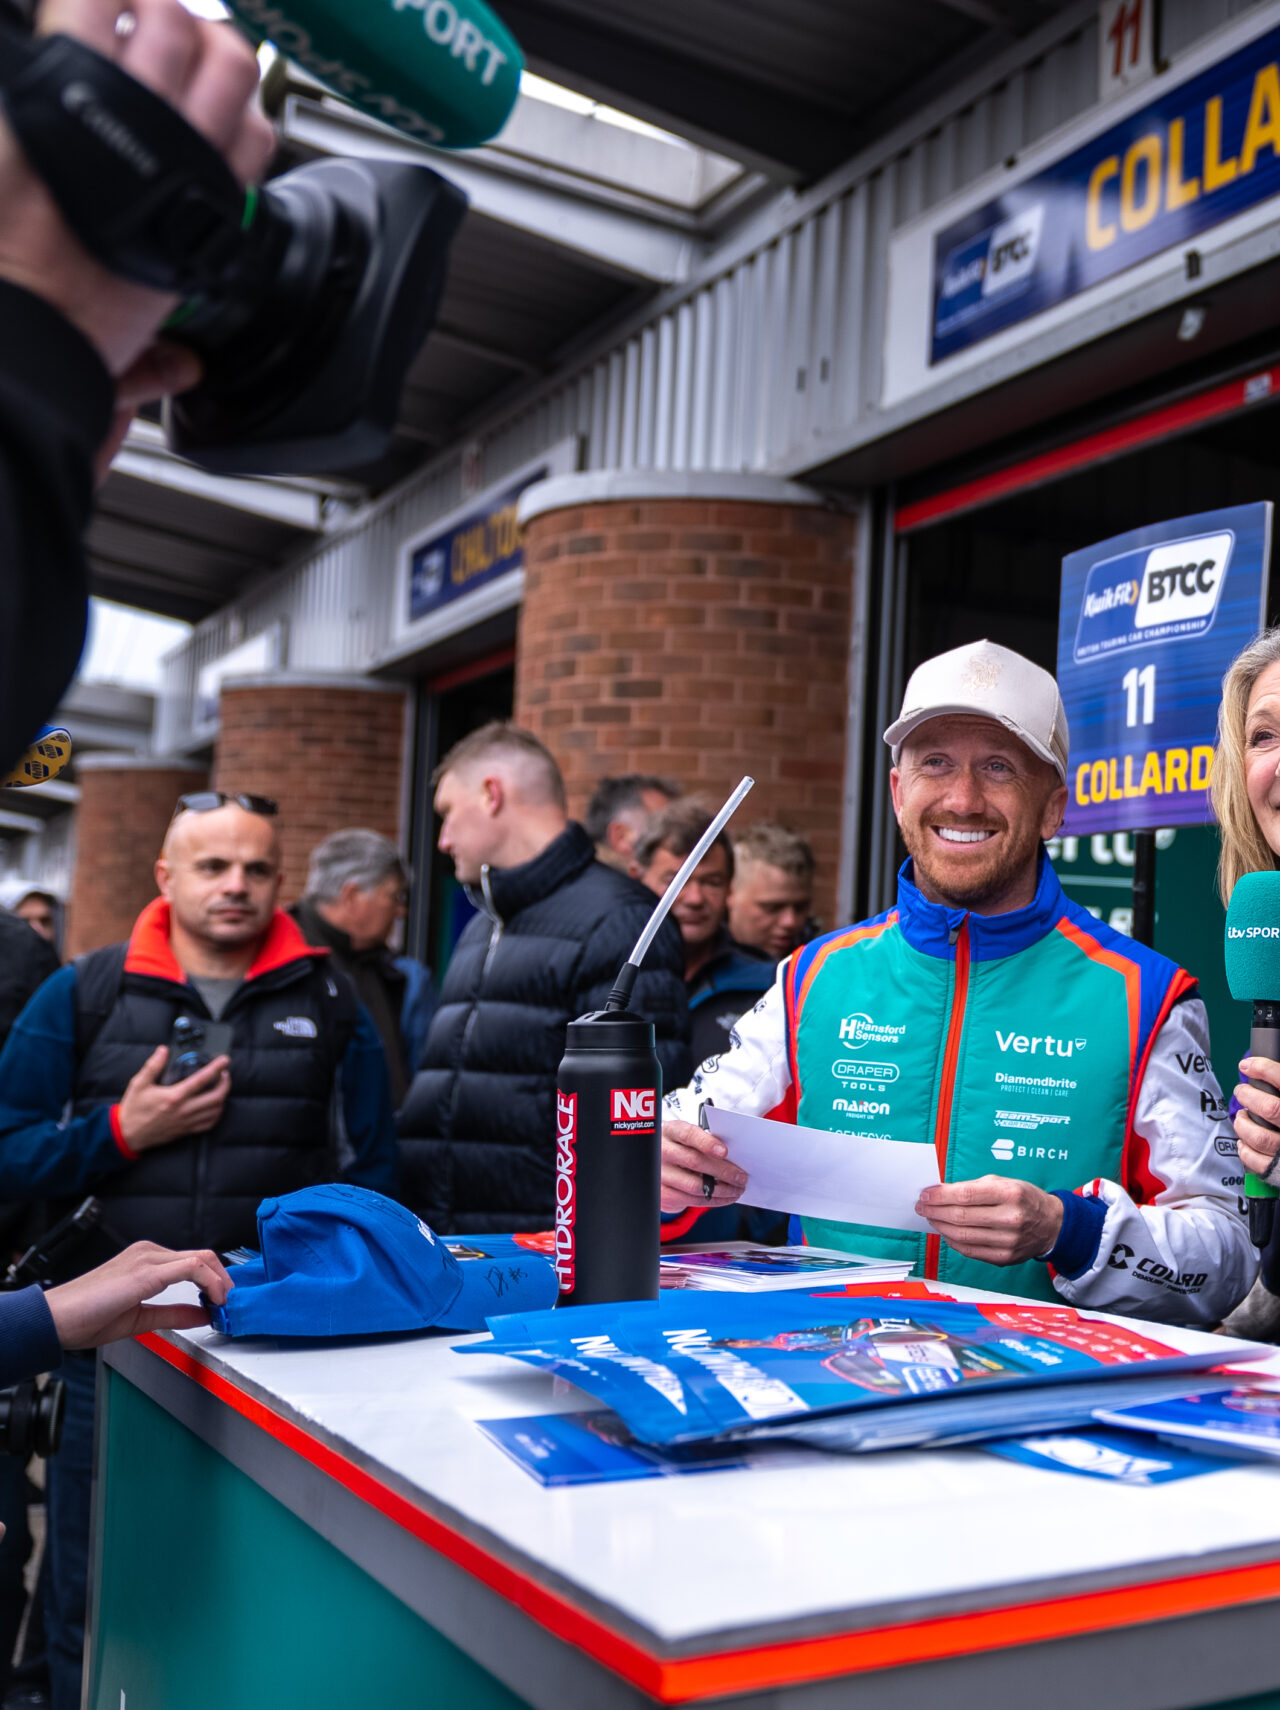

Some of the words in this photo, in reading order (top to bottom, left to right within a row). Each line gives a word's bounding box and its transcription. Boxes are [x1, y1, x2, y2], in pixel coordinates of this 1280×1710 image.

[393, 0, 507, 86] ORT
[1107, 0, 1142, 77] 11
[1147, 559, 1216, 604] BTCC
[1128, 631, 1143, 642] CAR
[1143, 619, 1207, 639] CHAMPIONSHIP
[1122, 664, 1156, 728] 11
[1075, 745, 1214, 806] COLLARD
[855, 1030, 899, 1043] Sensors
[856, 1021, 906, 1035] Hansford
[995, 1030, 1073, 1057] Vertu
[837, 1064, 894, 1078] DRAPER
[995, 1072, 1077, 1089] Diamondbrite
[841, 1081, 886, 1091] TOOLS
[614, 1090, 655, 1119] NG
[613, 1121, 655, 1131] nickygrist.com
[1017, 1146, 1068, 1160] BIRCH
[555, 1092, 575, 1291] HYDRORACE
